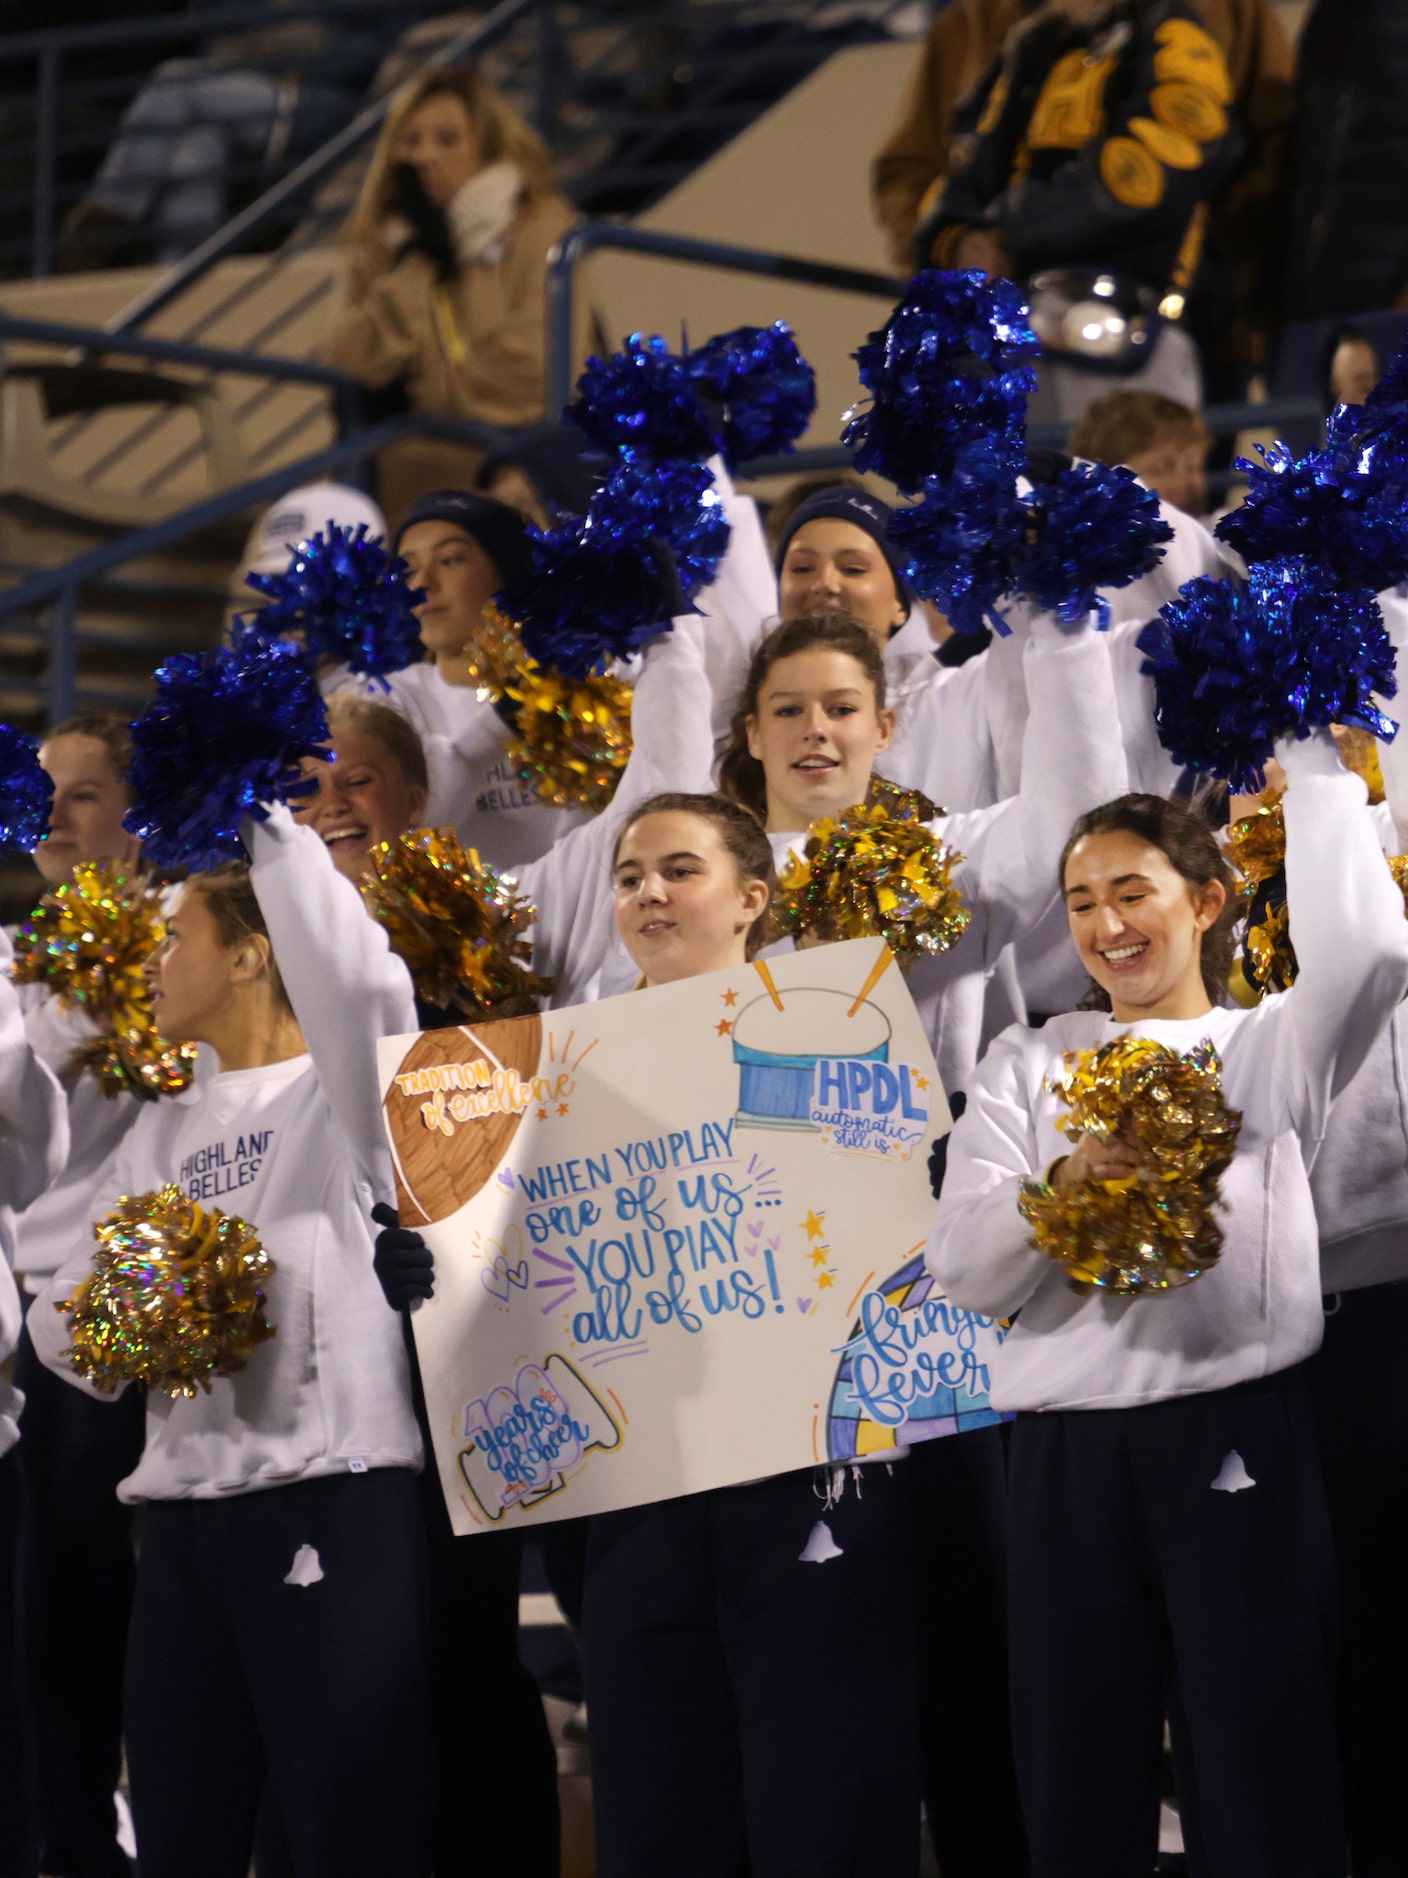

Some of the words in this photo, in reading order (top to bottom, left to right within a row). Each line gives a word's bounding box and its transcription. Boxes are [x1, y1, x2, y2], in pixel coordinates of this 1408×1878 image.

[395, 1059, 492, 1096] TRADITION
[818, 1060, 928, 1122] HPDL
[422, 1092, 454, 1135] of
[811, 1109, 925, 1141] automatic
[833, 1127, 871, 1150] still
[873, 1135, 891, 1154] is
[188, 1158, 262, 1203] BELLES
[518, 1153, 612, 1203] WHEN
[614, 1137, 668, 1177] YOU
[667, 1117, 735, 1168] PLAY
[524, 1199, 602, 1244] one
[614, 1175, 668, 1233] of
[564, 1228, 656, 1294] YOU
[572, 1280, 643, 1344] all
[645, 1268, 703, 1334] of
[698, 1249, 785, 1320] us!
[847, 1347, 991, 1426] fever
[474, 1395, 558, 1472] years
[503, 1443, 538, 1482] of
[526, 1413, 590, 1465] cheer
